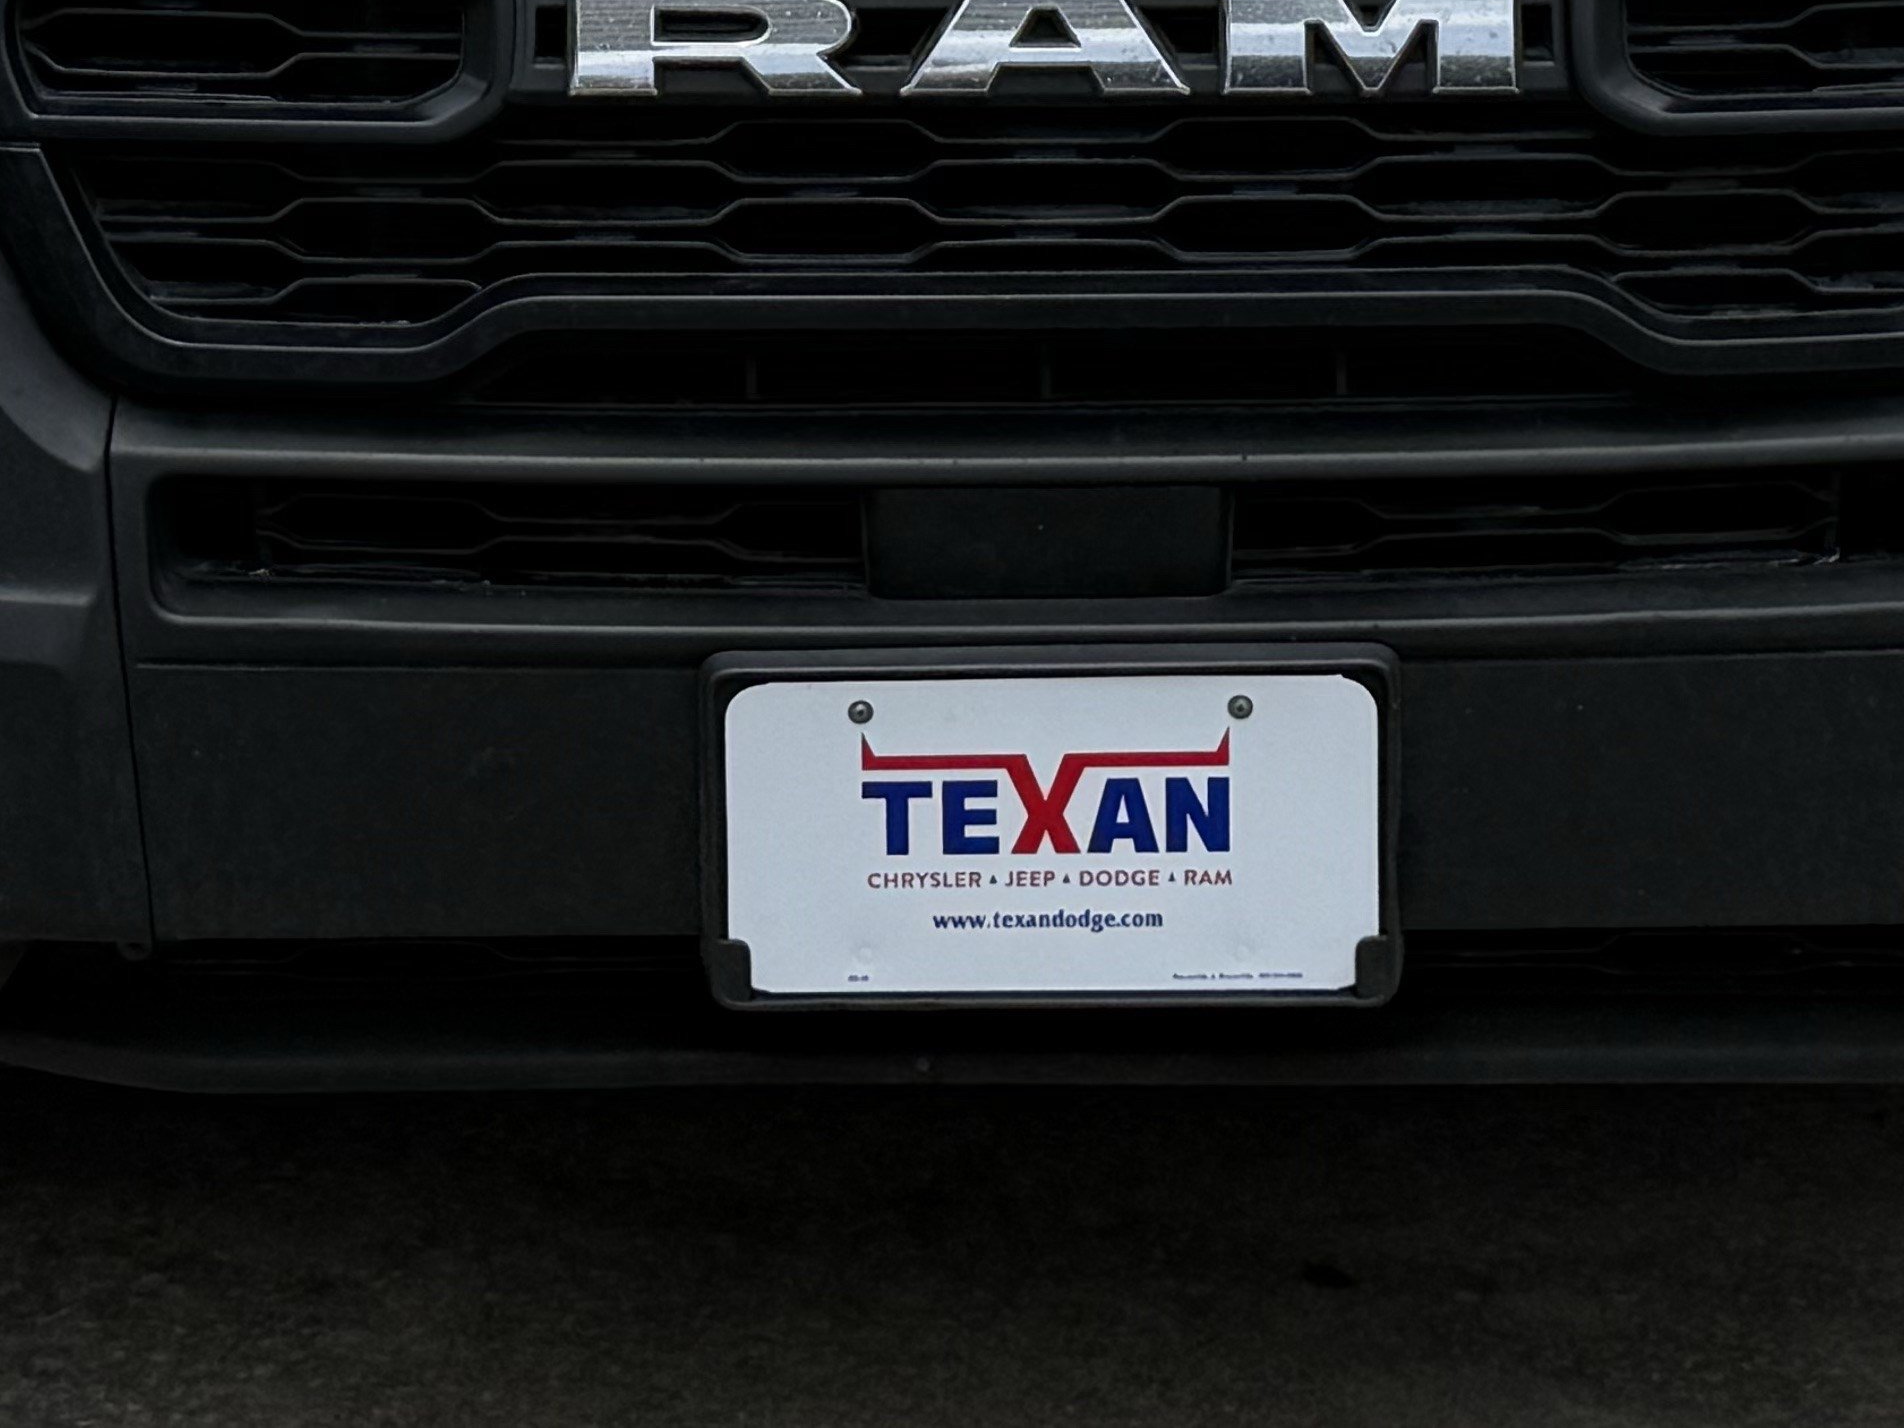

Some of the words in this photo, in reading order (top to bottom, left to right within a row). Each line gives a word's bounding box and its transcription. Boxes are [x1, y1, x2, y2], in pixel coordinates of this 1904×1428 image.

[861, 752, 1230, 856] TEXAN
[867, 871, 982, 889] CHRYSLER
[1004, 870, 1056, 888] JEEP
[1079, 869, 1161, 887] DODGE
[1183, 868, 1233, 886] RAM
[932, 908, 1164, 933] www.texandodge.com
